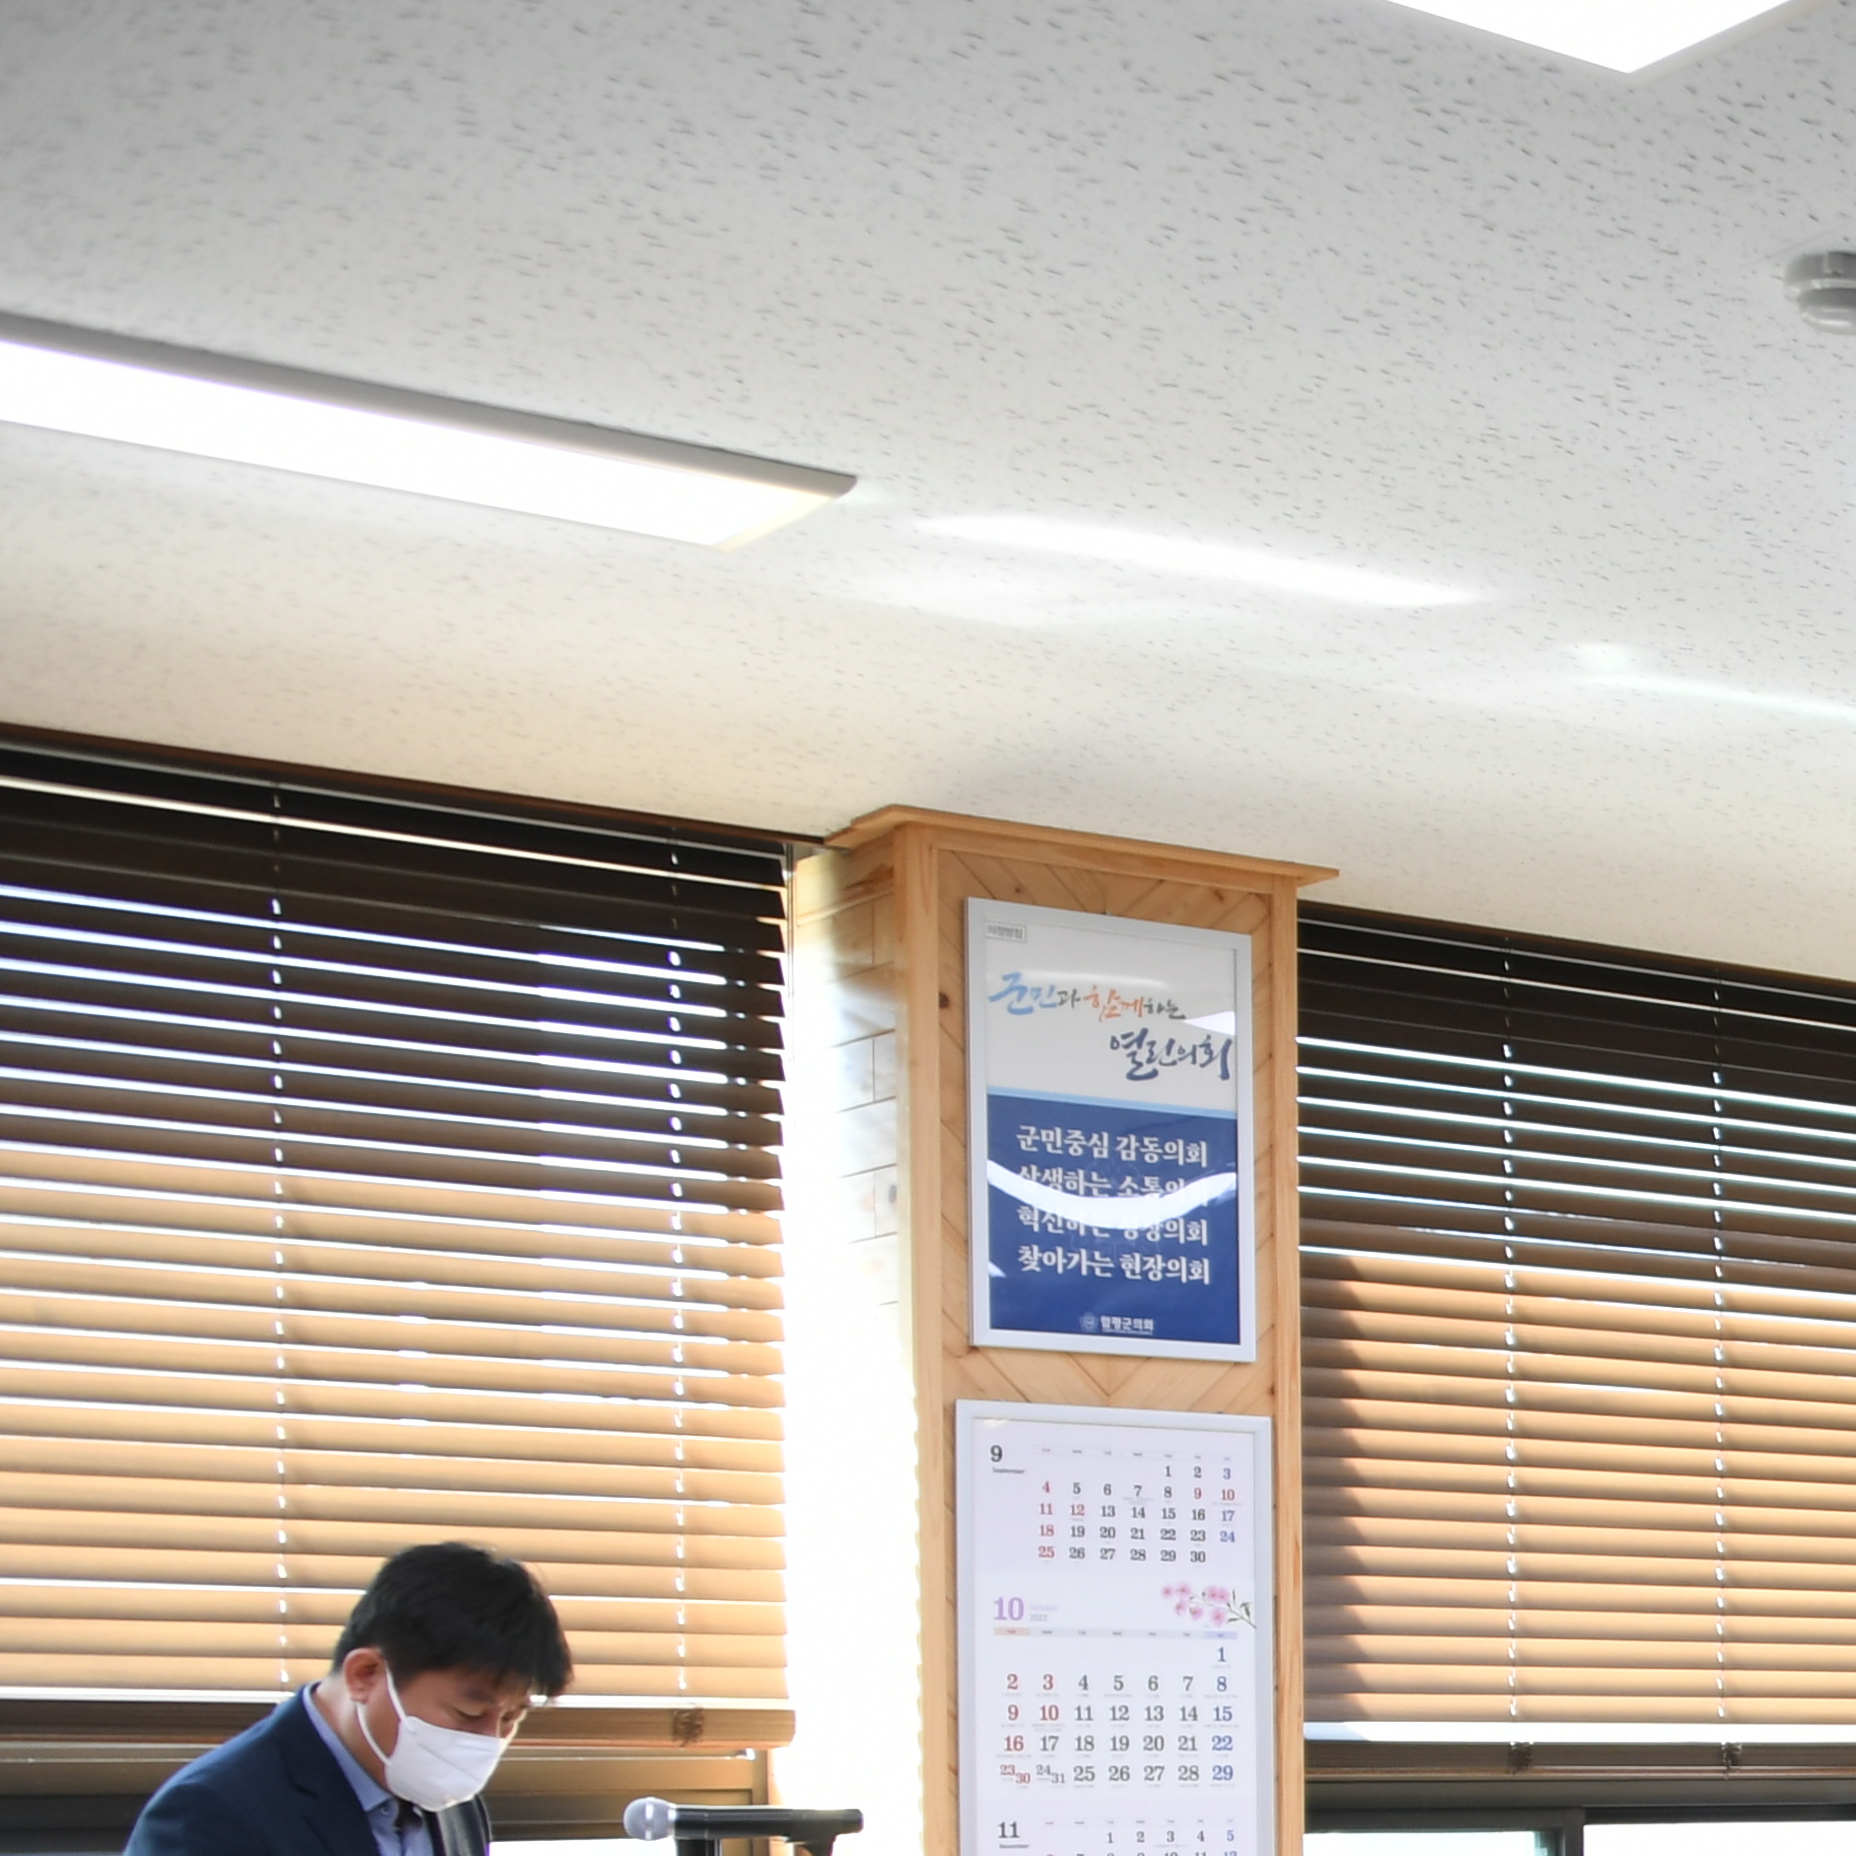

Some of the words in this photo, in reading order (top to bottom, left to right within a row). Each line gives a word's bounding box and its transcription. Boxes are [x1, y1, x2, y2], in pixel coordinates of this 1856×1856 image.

[988, 971, 1081, 1015] 군민과
[1083, 984, 1187, 1022] 함께하는
[1109, 1027, 1233, 1082] 열린의회
[1016, 1124, 1110, 1159] 군민중심
[1115, 1133, 1208, 1168] 감동의회
[1018, 1244, 1115, 1278] 찾아가는
[1119, 1250, 1210, 1285] 현장의회
[1100, 1315, 1154, 1331] 함평군의회
[990, 1445, 1003, 1463] 9
[1165, 1465, 1172, 1478] 1
[1193, 1466, 1203, 1479] 2
[1222, 1467, 1232, 1480] 3
[1042, 1481, 1051, 1494] 4
[1072, 1482, 1082, 1495] 5
[1103, 1483, 1112, 1496] 6
[1133, 1484, 1143, 1497] 7
[1164, 1486, 1173, 1499] 8
[1193, 1487, 1203, 1500] 9
[1221, 1488, 1236, 1501] 10
[1040, 1502, 1053, 1516] 11
[1070, 1503, 1086, 1517] 12
[1101, 1505, 1116, 1518] 13
[1132, 1506, 1146, 1519] 14
[1162, 1507, 1177, 1520] 15
[1192, 1508, 1206, 1521] 16
[1221, 1509, 1236, 1522] 17
[1040, 1524, 1055, 1537] 18
[1070, 1525, 1086, 1538] 19
[1099, 1526, 1116, 1539] 20
[1130, 1527, 1146, 1541] 21
[1159, 1528, 1177, 1541] 22
[1189, 1529, 1207, 1542] 23
[1219, 1530, 1236, 1543] 24
[1038, 1545, 1055, 1559] 25
[1068, 1546, 1086, 1560] 26
[1099, 1547, 1116, 1561] 27
[1129, 1548, 1147, 1562] 28
[1160, 1549, 1177, 1562] 29
[1190, 1550, 1206, 1563] 30
[993, 1597, 1025, 1622] 10
[1218, 1646, 1226, 1663] 1
[1006, 1673, 1019, 1691] 2
[1042, 1673, 1054, 1691] 3
[1078, 1674, 1089, 1691] 4
[1113, 1674, 1125, 1692] 5
[1147, 1675, 1159, 1692] 6
[1182, 1675, 1194, 1692] 7
[1216, 1675, 1228, 1692] 8
[1007, 1704, 1019, 1721] 9
[1040, 1704, 1060, 1722] 10
[1075, 1705, 1094, 1722] 11
[1110, 1704, 1130, 1722] 12
[1145, 1704, 1165, 1722] 13
[1180, 1705, 1198, 1722] 14
[1213, 1705, 1233, 1722] 15
[1004, 1734, 1025, 1752] 16
[1040, 1735, 1060, 1752] 17
[1075, 1734, 1095, 1752] 18
[1110, 1735, 1130, 1752] 19
[1142, 1735, 1165, 1752] 20
[1177, 1735, 1198, 1752] 21
[1211, 1735, 1234, 1752] 22
[999, 1764, 1015, 1777] 23
[1014, 1769, 1031, 1784] 30
[1035, 1764, 1052, 1777] 24
[1049, 1769, 1066, 1784] 31
[1073, 1765, 1096, 1782] 25
[1108, 1765, 1131, 1782] 26
[1143, 1765, 1165, 1782] 27
[1177, 1765, 1200, 1782] 28
[1212, 1764, 1234, 1781] 29
[998, 1821, 1020, 1839] 11
[1107, 1831, 1114, 1844] 1
[1136, 1830, 1146, 1844] 2
[1166, 1830, 1175, 1843] 3
[1196, 1830, 1205, 1843] 4
[1226, 1829, 1235, 1842] 5
